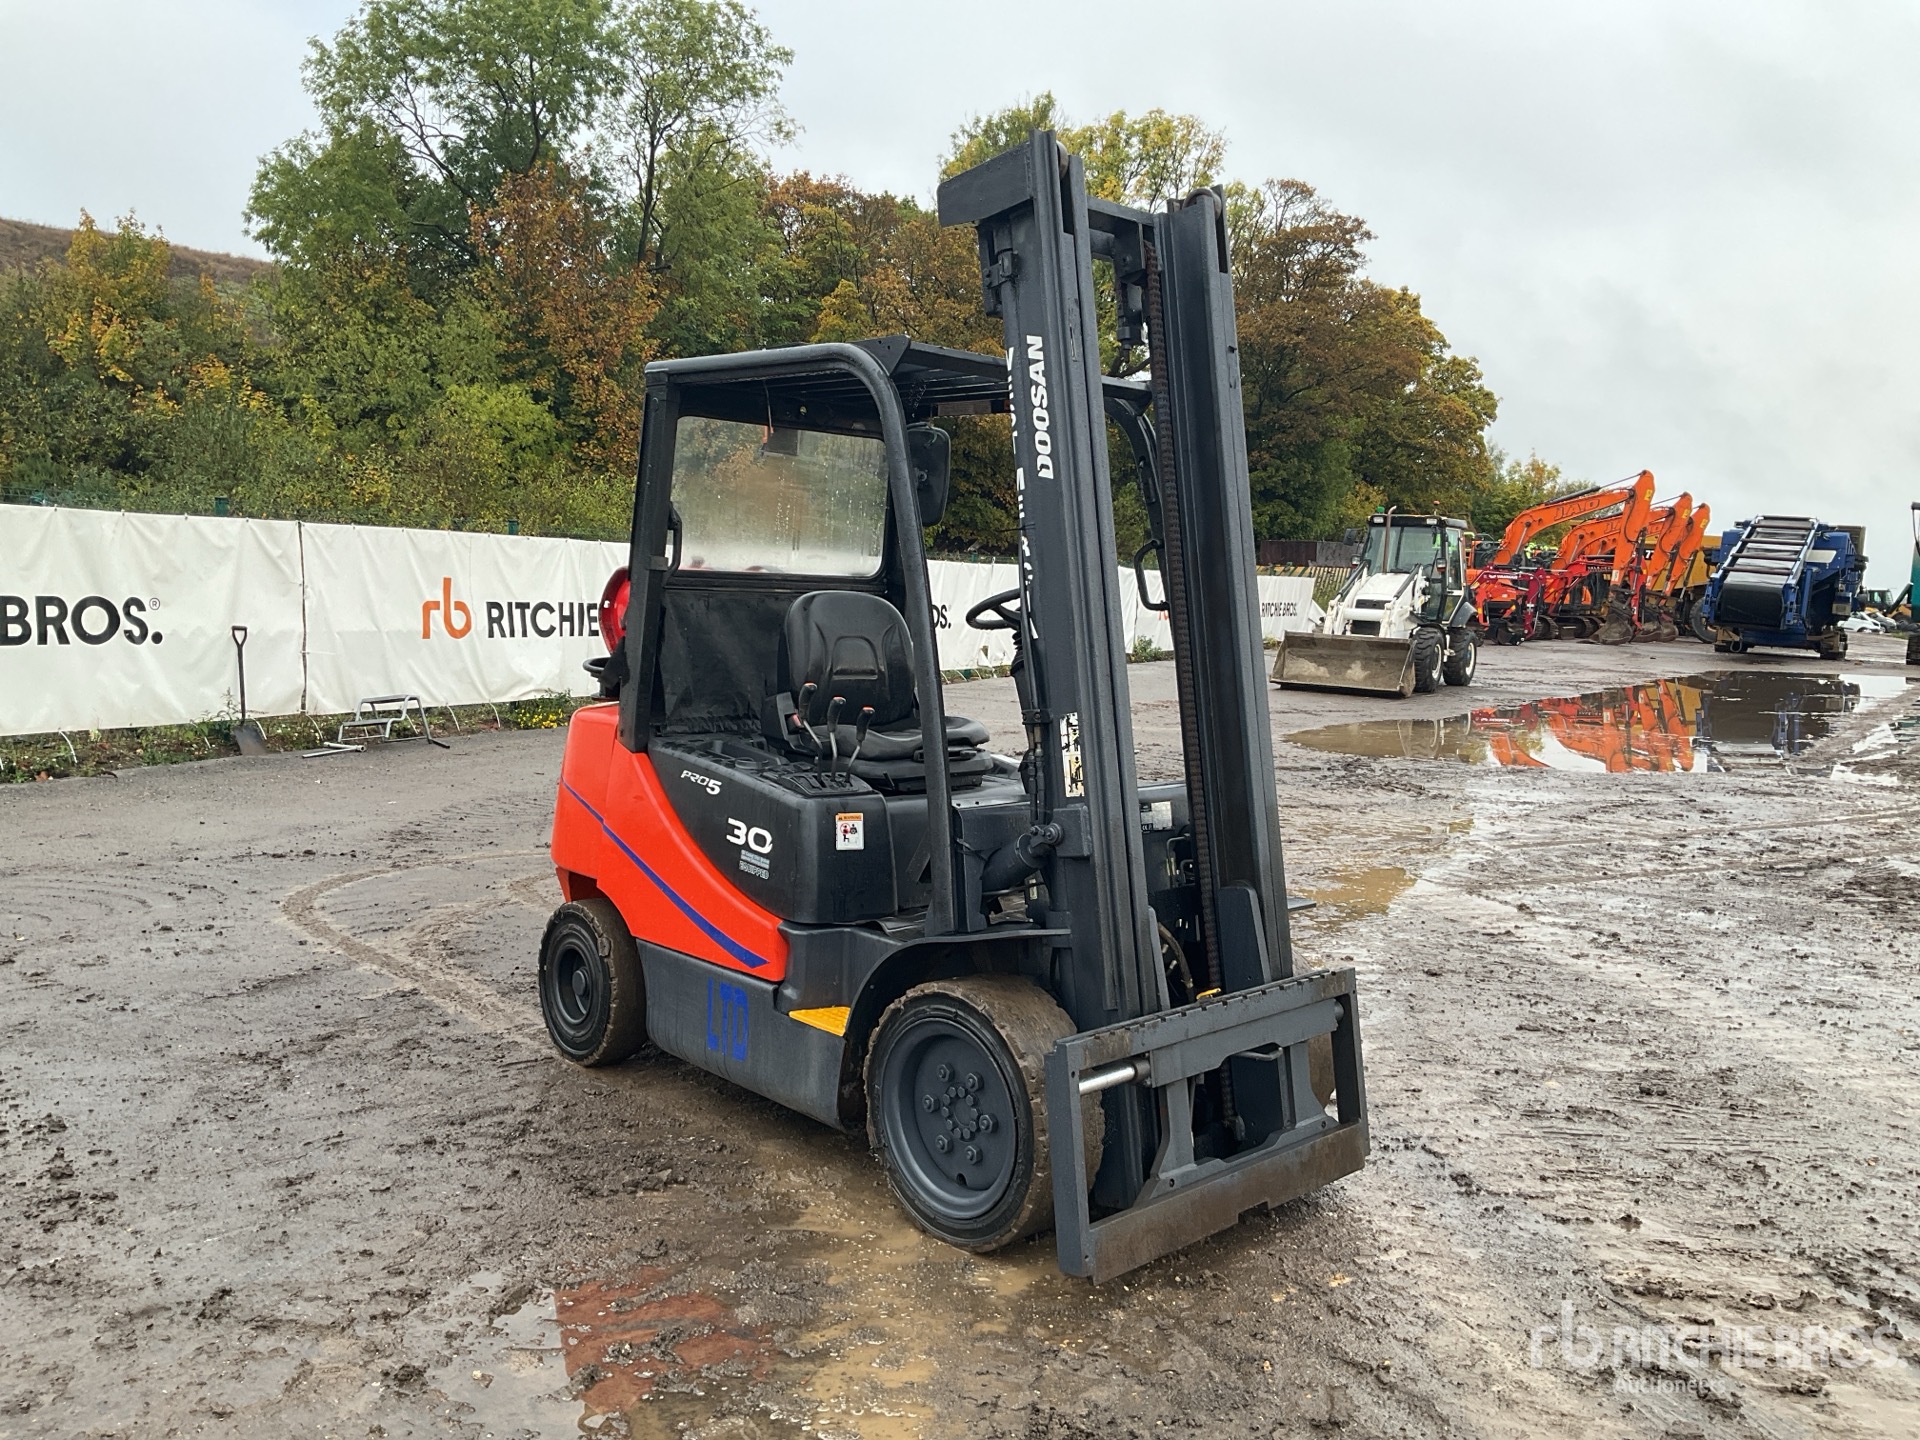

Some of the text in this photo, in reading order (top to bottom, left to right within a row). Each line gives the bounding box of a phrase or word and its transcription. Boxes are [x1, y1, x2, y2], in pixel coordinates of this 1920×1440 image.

[1026, 335, 1054, 479] DOOSAN
[486, 601, 600, 638] RITCHIE
[680, 769, 723, 795] PRO5
[726, 817, 773, 854] 30
[706, 976, 749, 1062] LTD
